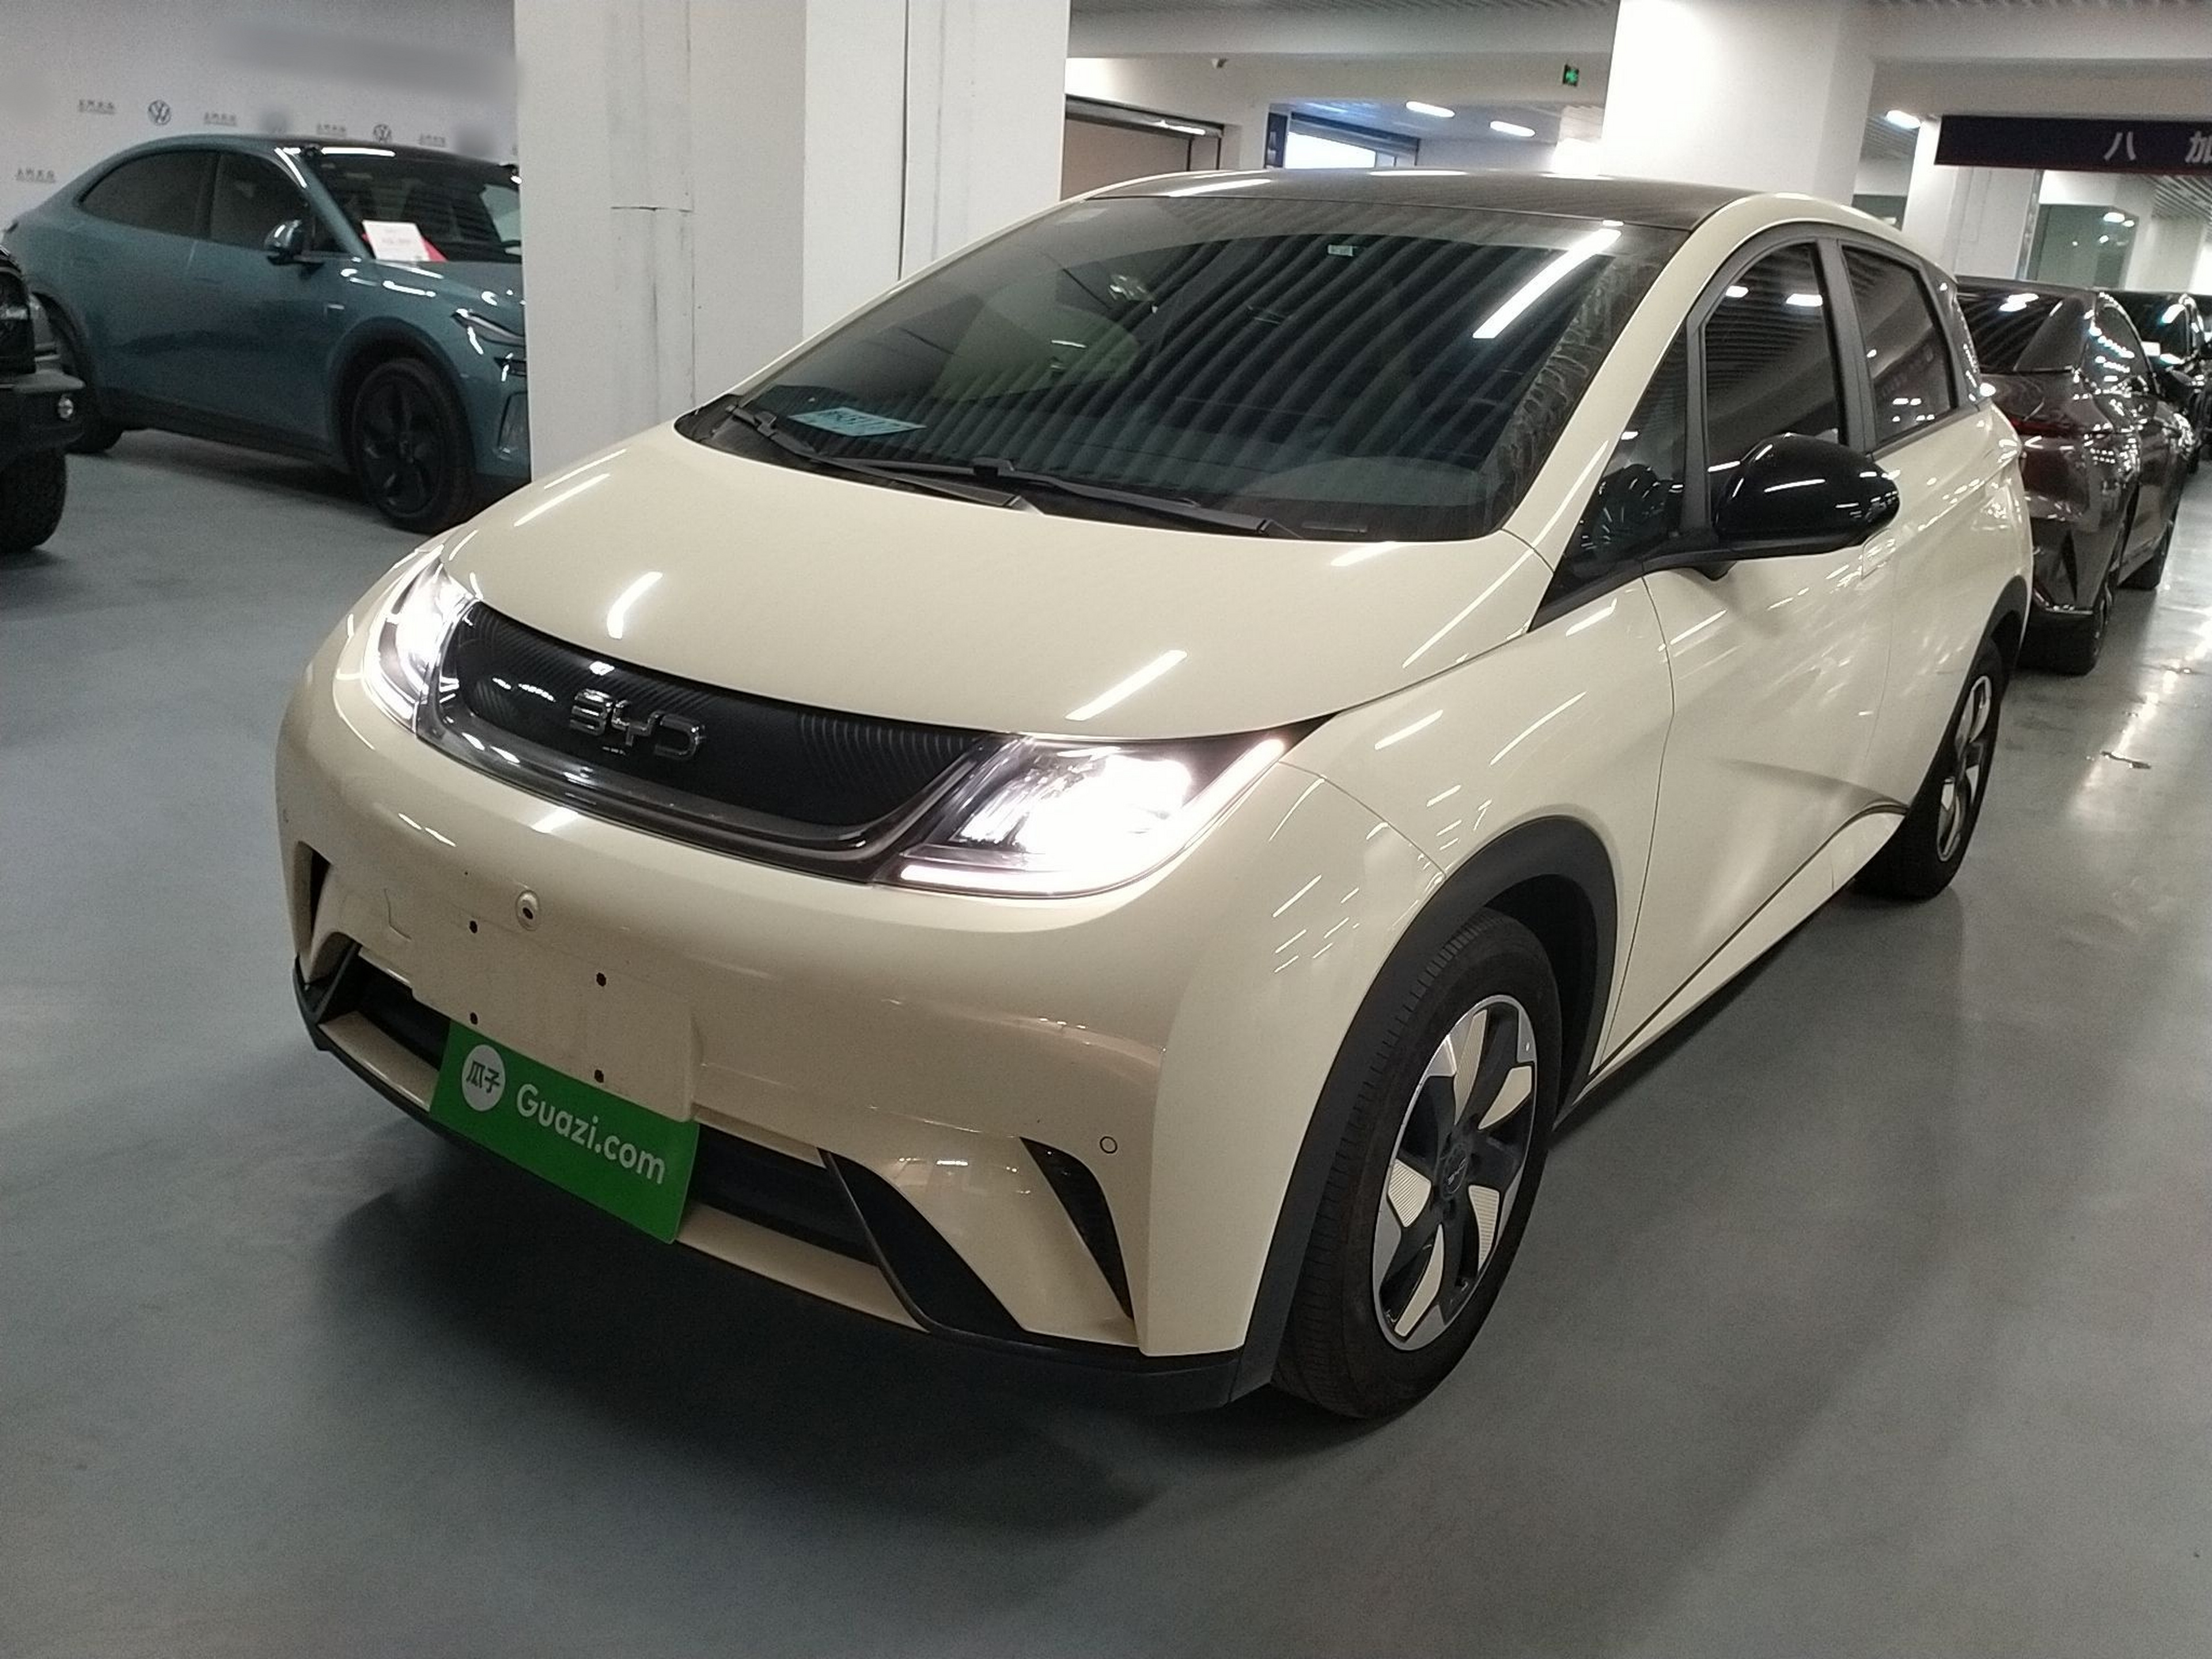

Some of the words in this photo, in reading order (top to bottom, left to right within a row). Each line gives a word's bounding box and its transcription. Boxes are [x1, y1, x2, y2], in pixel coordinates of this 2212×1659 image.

[570, 688, 701, 761] BYD
[465, 1060, 501, 1094] 瓜子
[516, 1084, 666, 1185] Guazi.com
